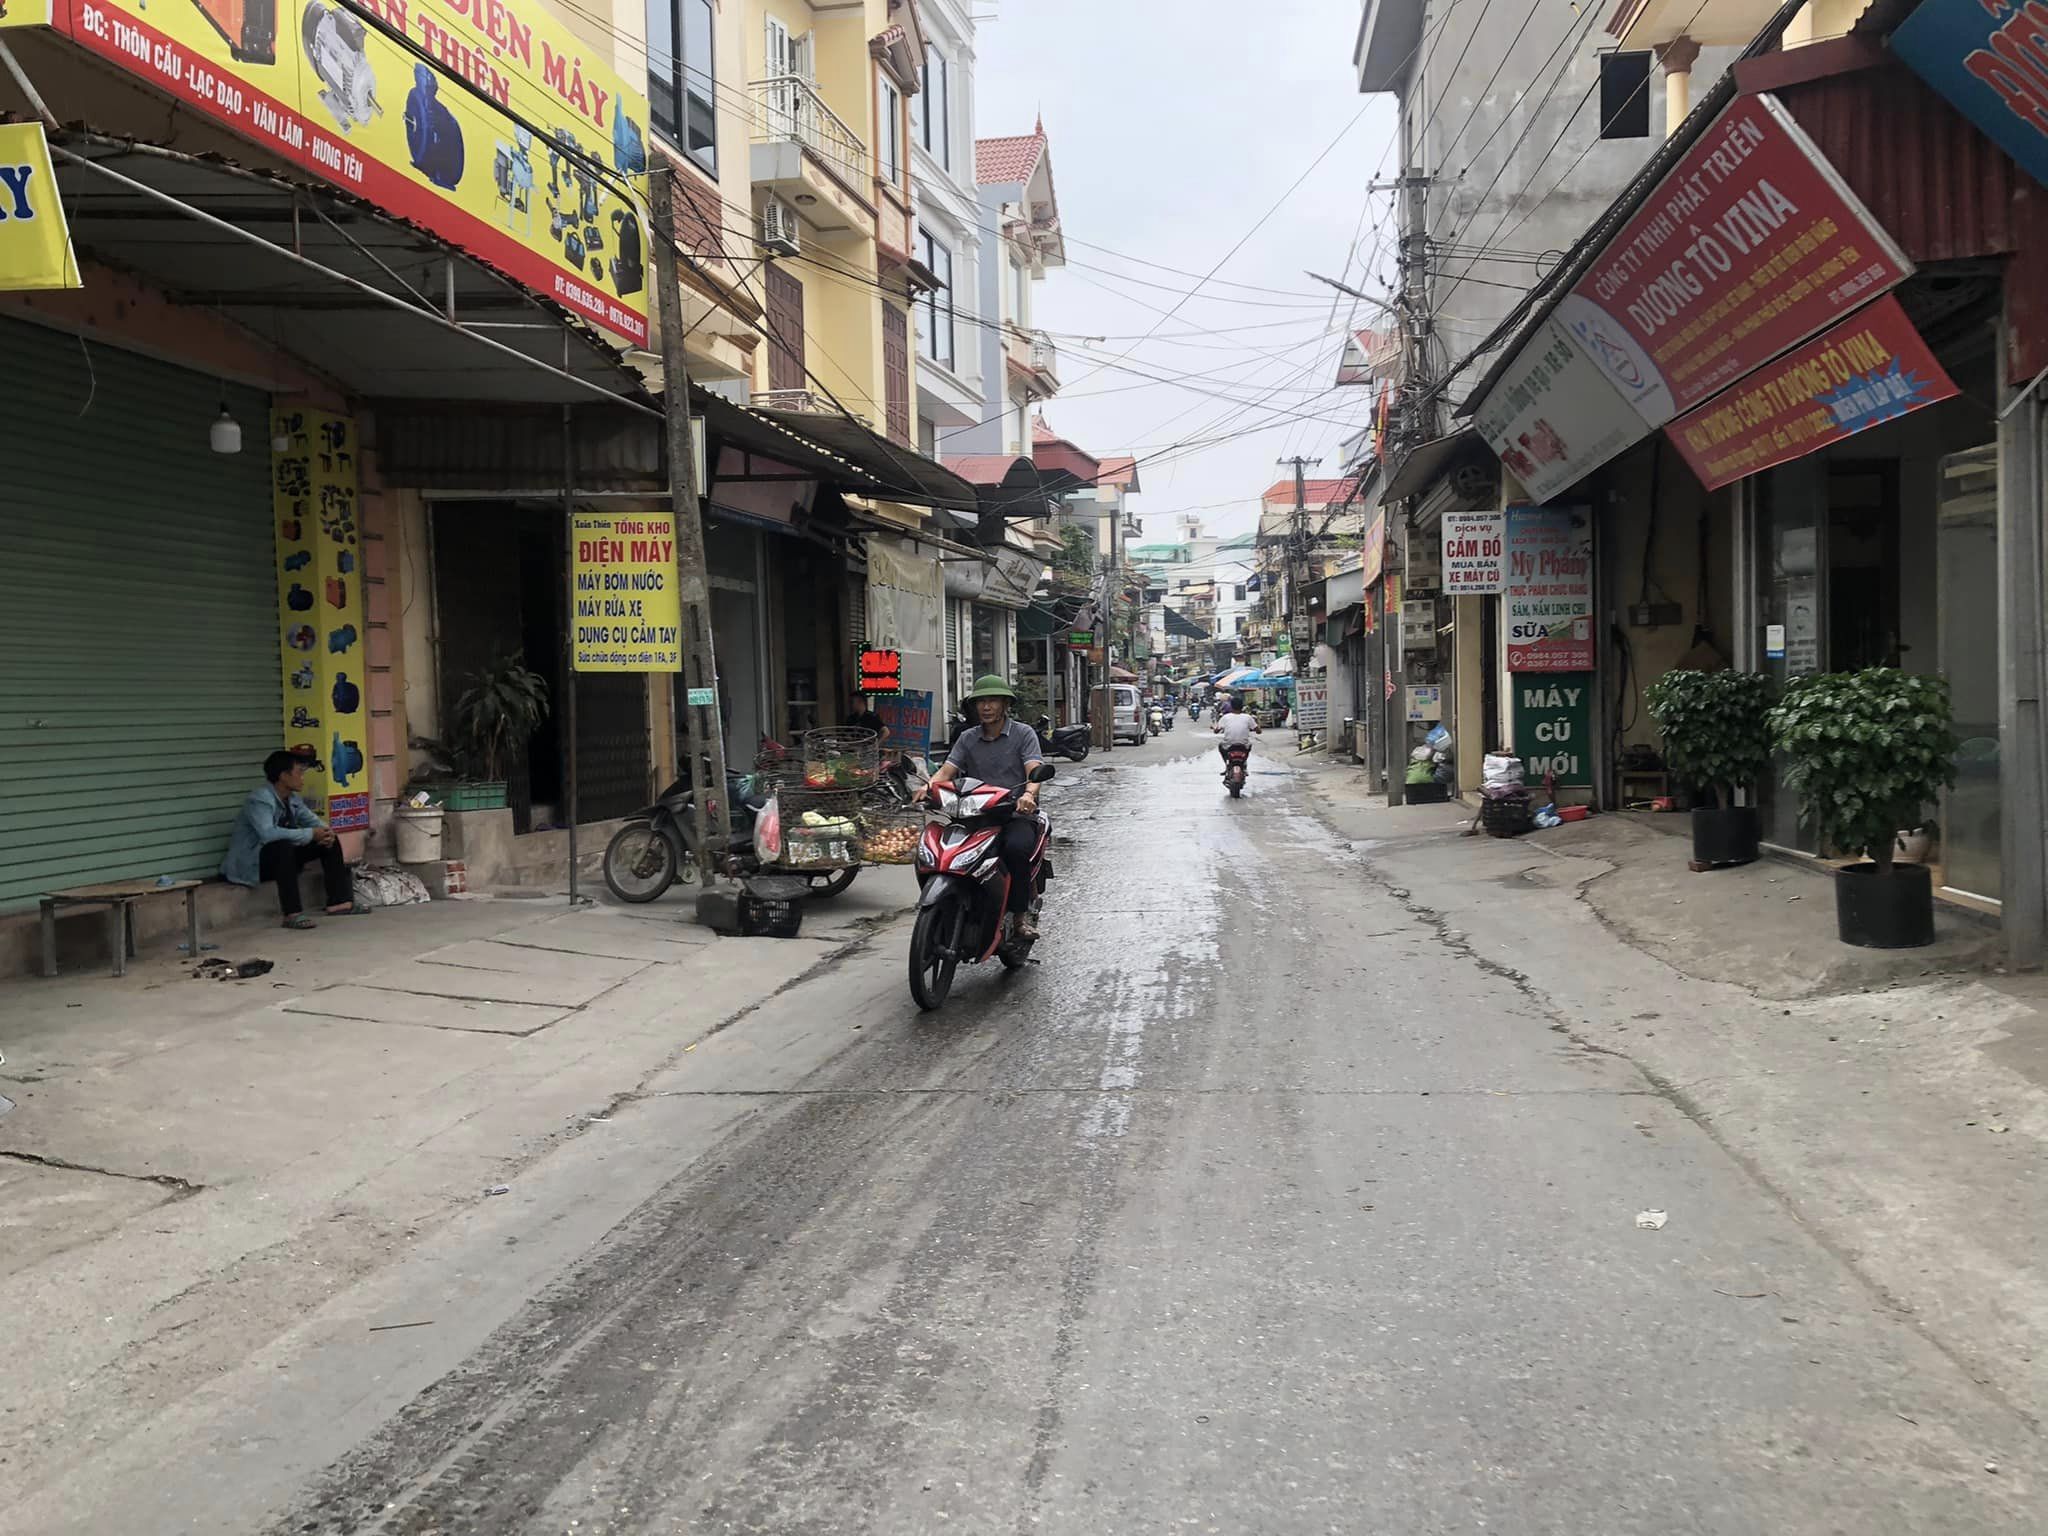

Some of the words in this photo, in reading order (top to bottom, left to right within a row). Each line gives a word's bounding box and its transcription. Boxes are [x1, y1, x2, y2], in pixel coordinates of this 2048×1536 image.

[83, 3, 109, 40] ĐC:
[112, 19, 150, 64] THÔN
[217, 80, 242, 115] ĐẠO
[253, 100, 276, 135] VĂN
[279, 116, 303, 150] LÂM
[312, 135, 341, 171] HƯNG
[344, 153, 363, 183] YÊN
[541, 39, 608, 128] MÁY
[0, 165, 33, 219] Y
[1595, 262, 1629, 301] CÔNG
[1619, 247, 1643, 273] TY
[1634, 211, 1676, 253] TNHH
[1665, 170, 1711, 225] PHÁT
[1702, 115, 1765, 184] TRIỂN
[1626, 259, 1704, 337] DƯƠNG
[1684, 223, 1732, 283] TÔ
[1713, 178, 1800, 255] VINA
[1839, 328, 1892, 374] VINA
[614, 516, 644, 535] TỔNG
[647, 521, 670, 535] KHO
[1455, 523, 1476, 534] DỊCH
[1480, 525, 1492, 534] VỤ
[578, 535, 624, 568] ĐIỆN
[630, 535, 673, 563] MÁY
[1451, 561, 1474, 569] MUA
[1477, 559, 1498, 568] BÁN
[578, 568, 601, 591] MÁY
[604, 571, 629, 591] BƠM
[631, 568, 664, 591] NƯỚC
[1448, 571, 1461, 583] XE
[1463, 568, 1484, 583] MÁY
[1487, 568, 1500, 582] CŨ
[578, 595, 601, 617] MÁY
[604, 593, 626, 617] RỬA
[629, 599, 642, 617] XE
[578, 626, 609, 648] DỤNG
[612, 626, 628, 648] CỤ
[658, 626, 677, 644] TAY
[1512, 621, 1549, 638] SỮA
[1523, 683, 1581, 708] MÁY
[1535, 716, 1571, 742] CŨ
[1529, 750, 1578, 775] MỚI
